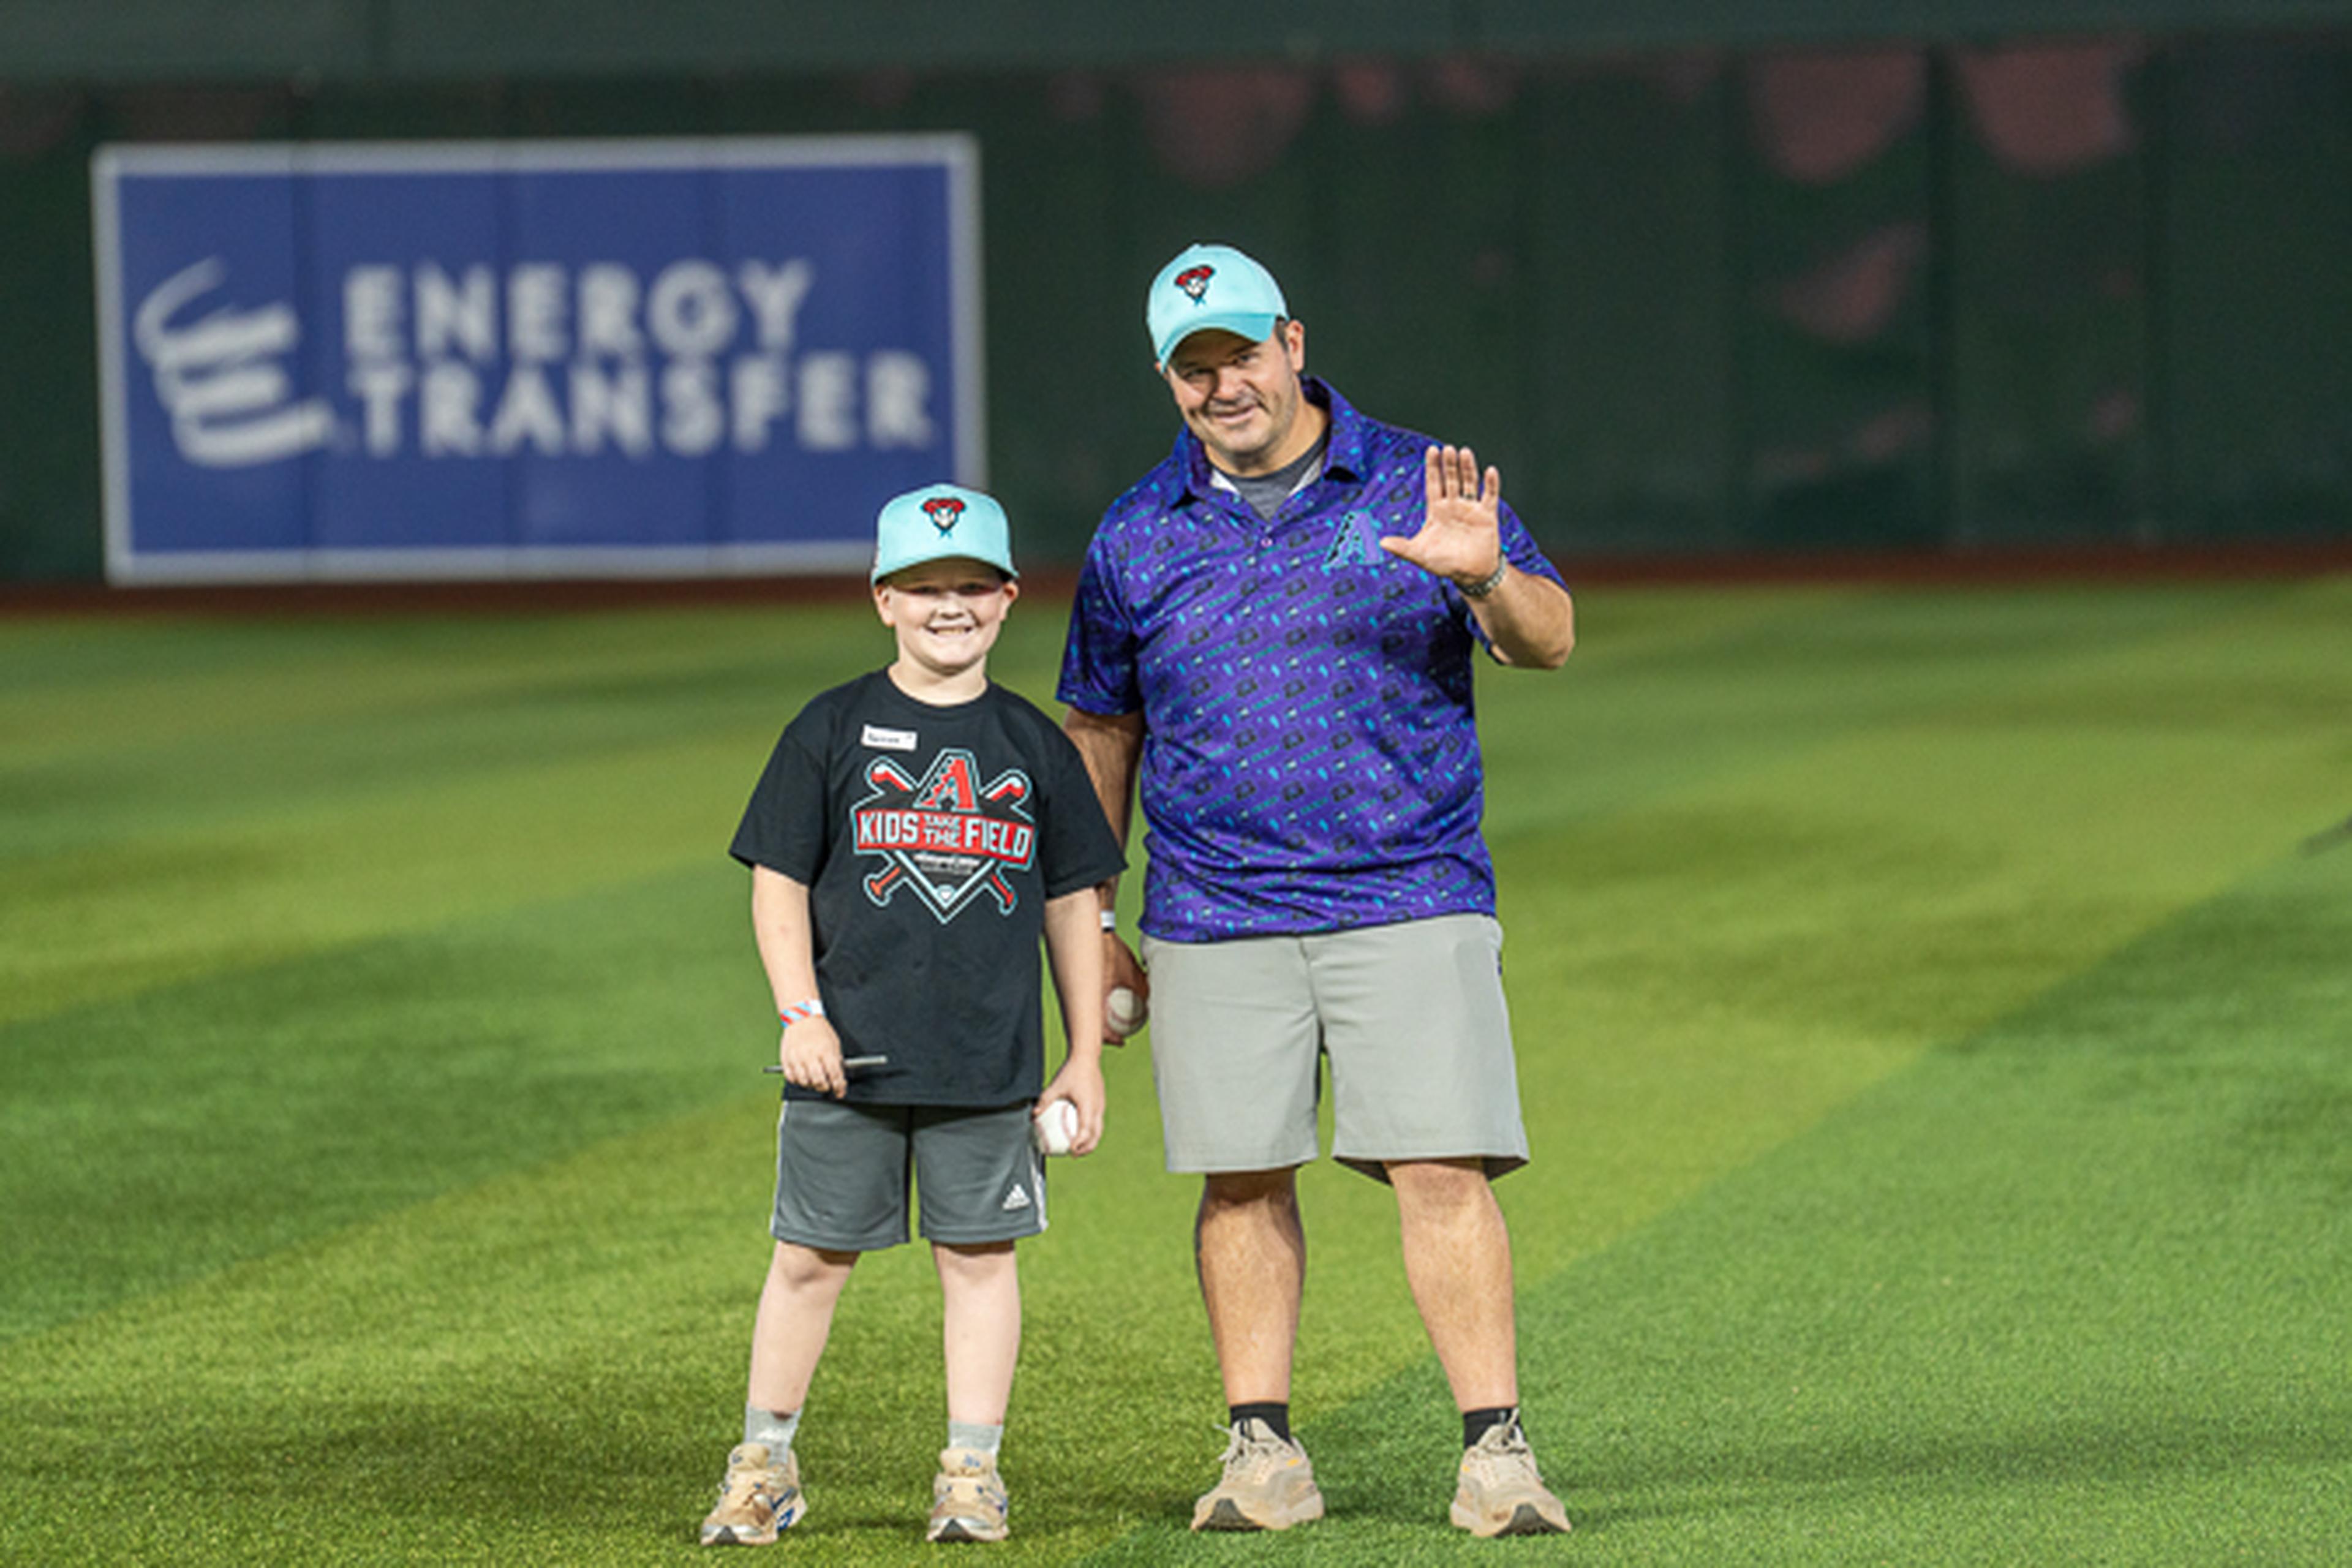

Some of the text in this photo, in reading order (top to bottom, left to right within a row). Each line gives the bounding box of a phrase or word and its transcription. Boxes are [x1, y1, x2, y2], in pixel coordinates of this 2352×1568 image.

[344, 260, 810, 360] ENERGY
[347, 353, 936, 456] TRANSFER
[914, 753, 978, 811] A
[860, 812, 918, 843] KIDS
[924, 828, 960, 847] THE
[965, 818, 1030, 858] FIELD
